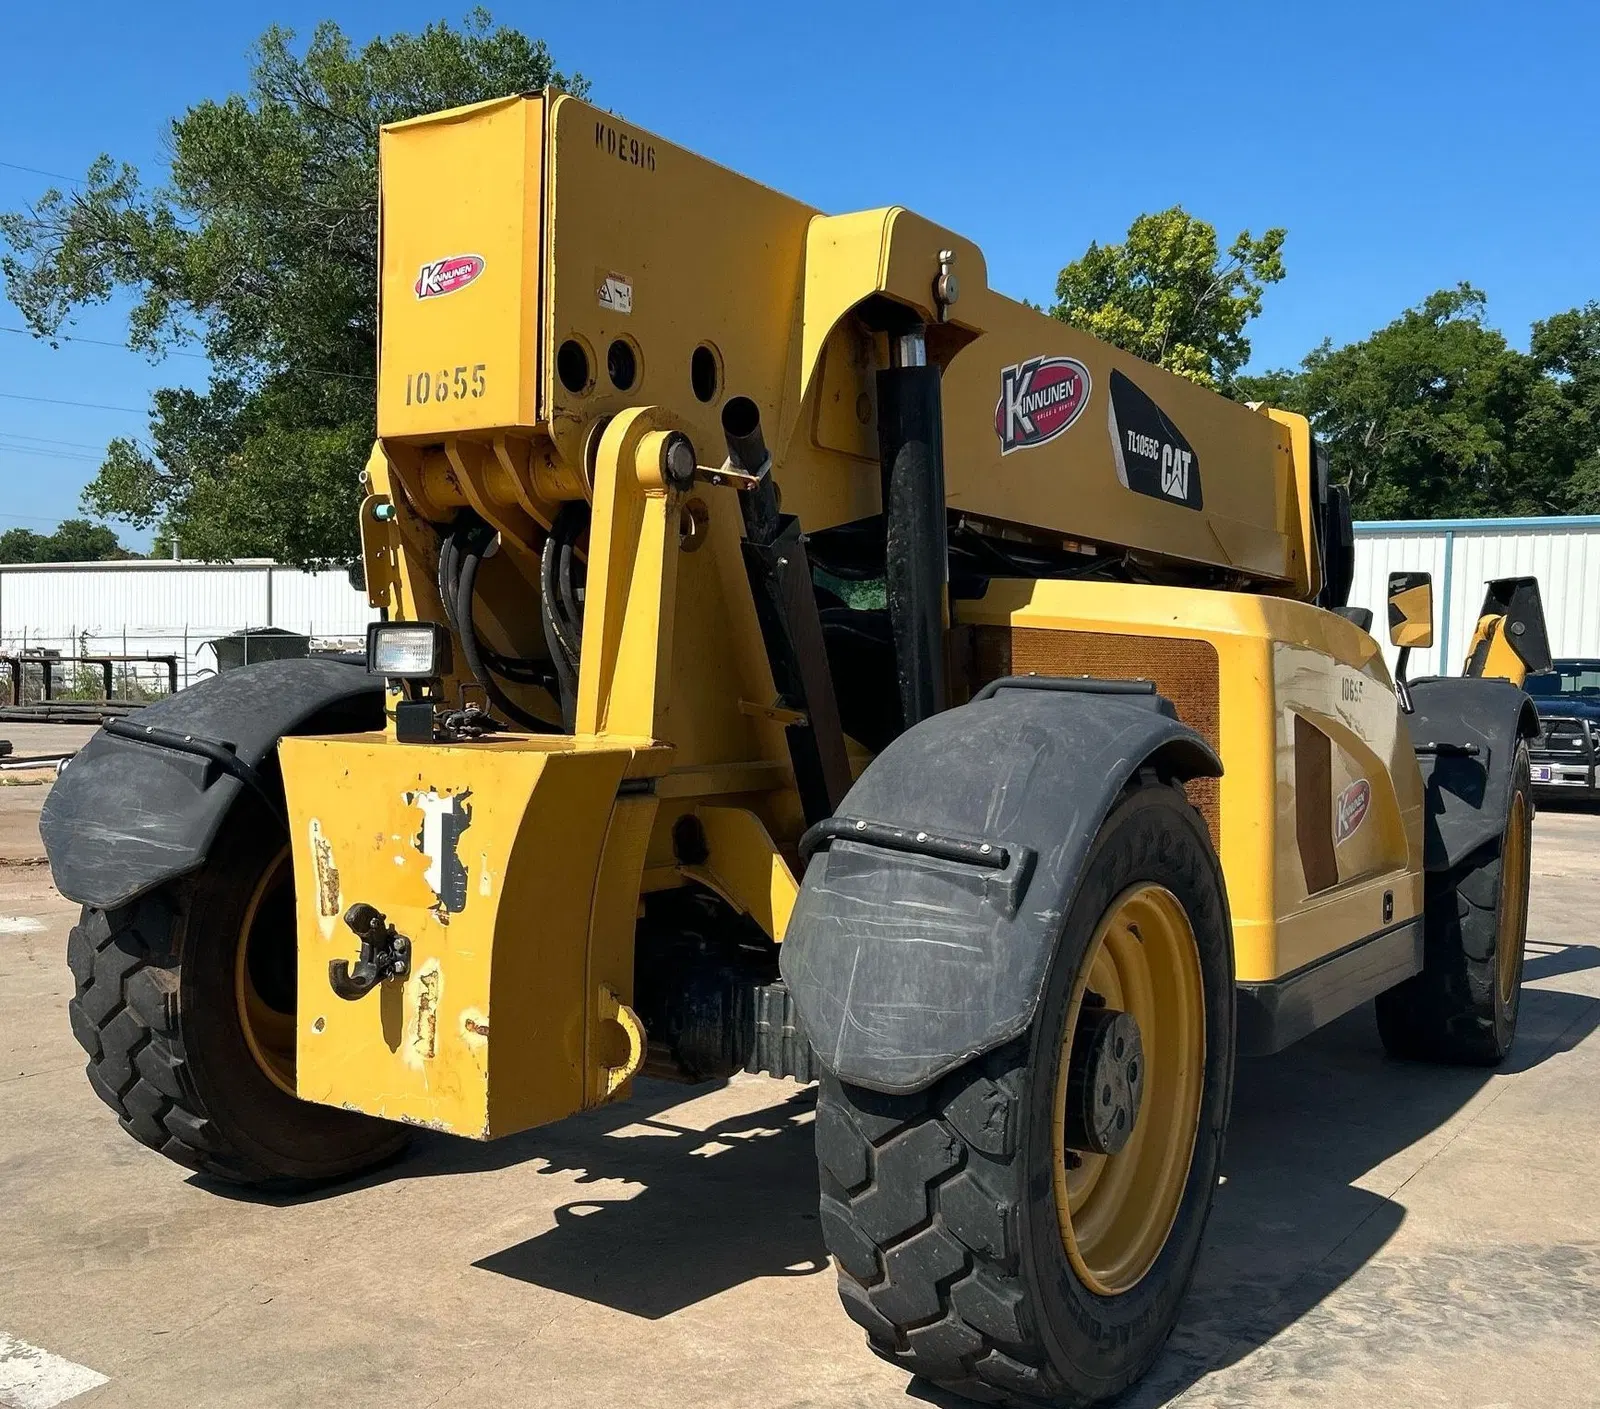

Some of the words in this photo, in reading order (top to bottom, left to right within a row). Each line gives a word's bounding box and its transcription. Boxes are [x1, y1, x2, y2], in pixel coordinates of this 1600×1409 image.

[595, 121, 656, 172] KDE916
[420, 262, 473, 298] KINNUNEN
[406, 363, 487, 406] 10655
[1003, 364, 1075, 447] KINNUNEN
[1127, 430, 1159, 461] TL1055C
[1161, 443, 1192, 500] CAT
